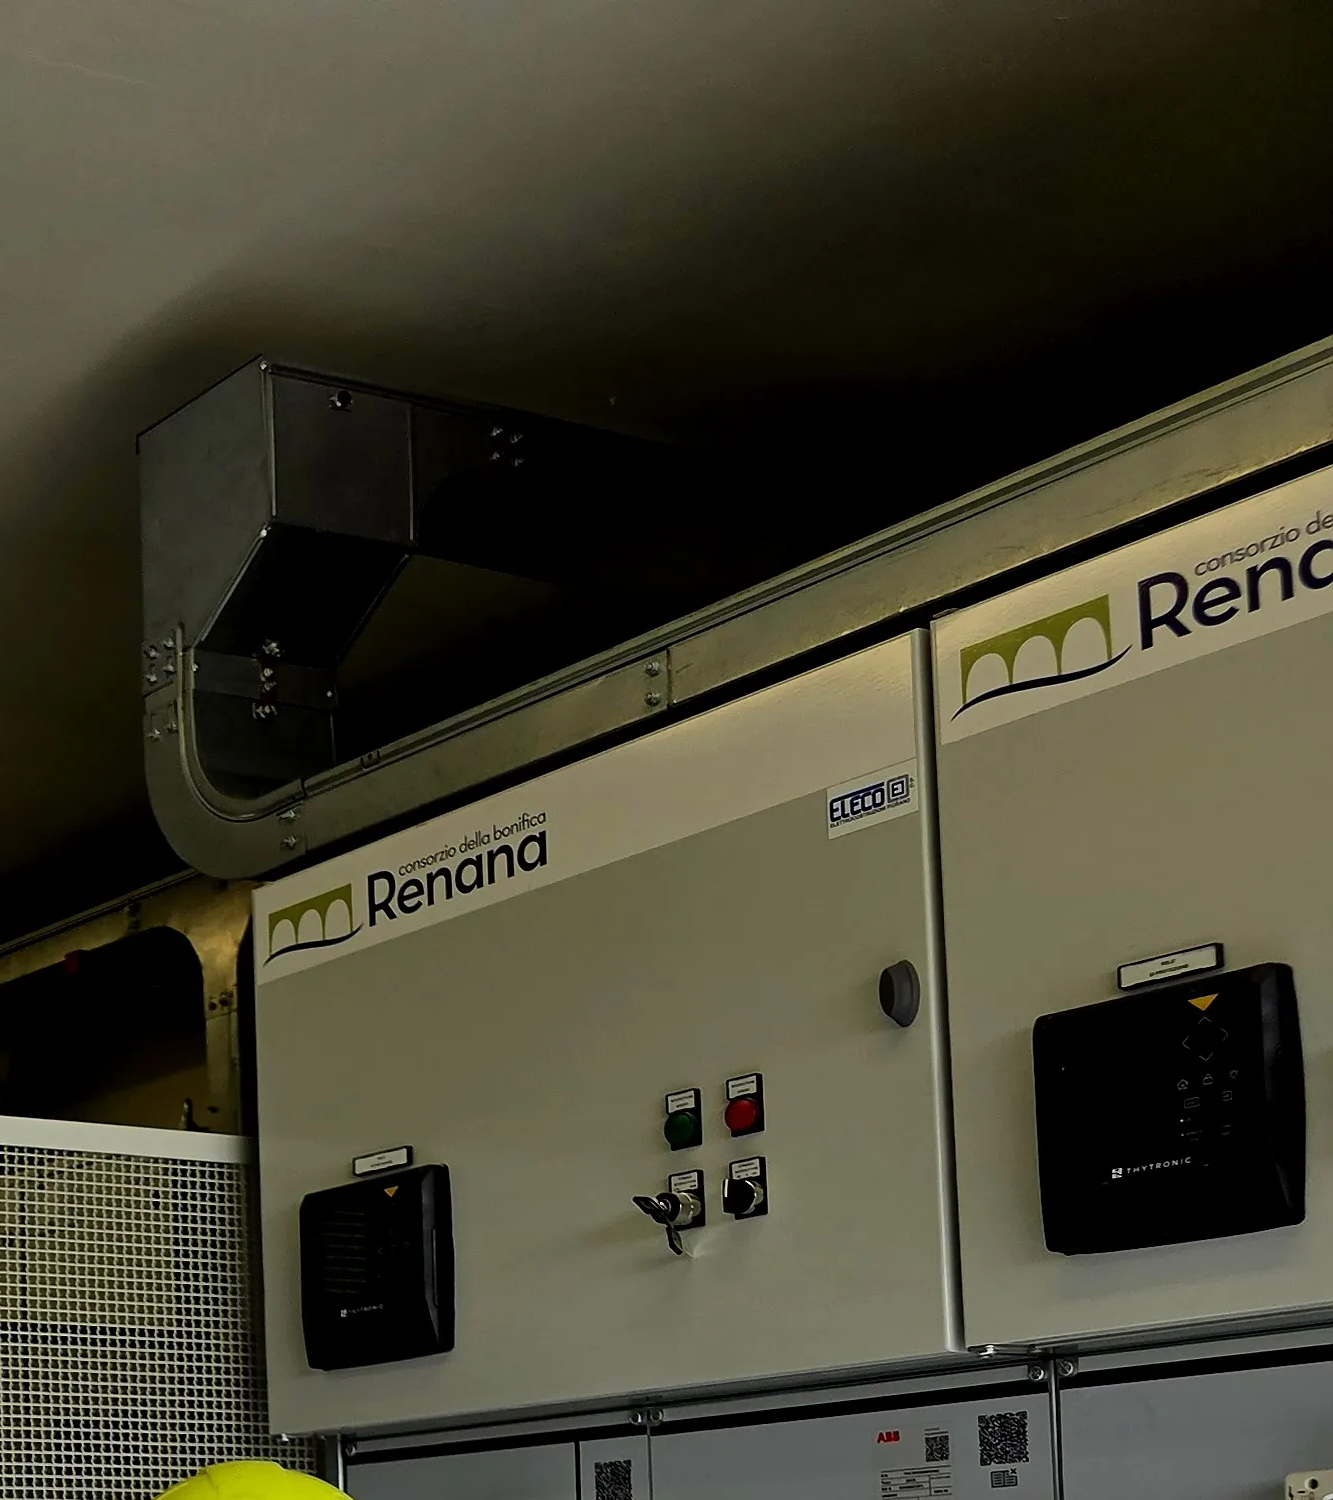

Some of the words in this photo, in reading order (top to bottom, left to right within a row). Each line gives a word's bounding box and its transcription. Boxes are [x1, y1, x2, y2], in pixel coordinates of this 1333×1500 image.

[1194, 526, 1301, 576] consorzio
[829, 781, 885, 822] ELECO
[398, 846, 456, 876] consorzio
[459, 831, 490, 853] della
[493, 811, 547, 841] bonifica
[366, 830, 548, 927] Renana
[1126, 1156, 1192, 1174] THYTRONIC
